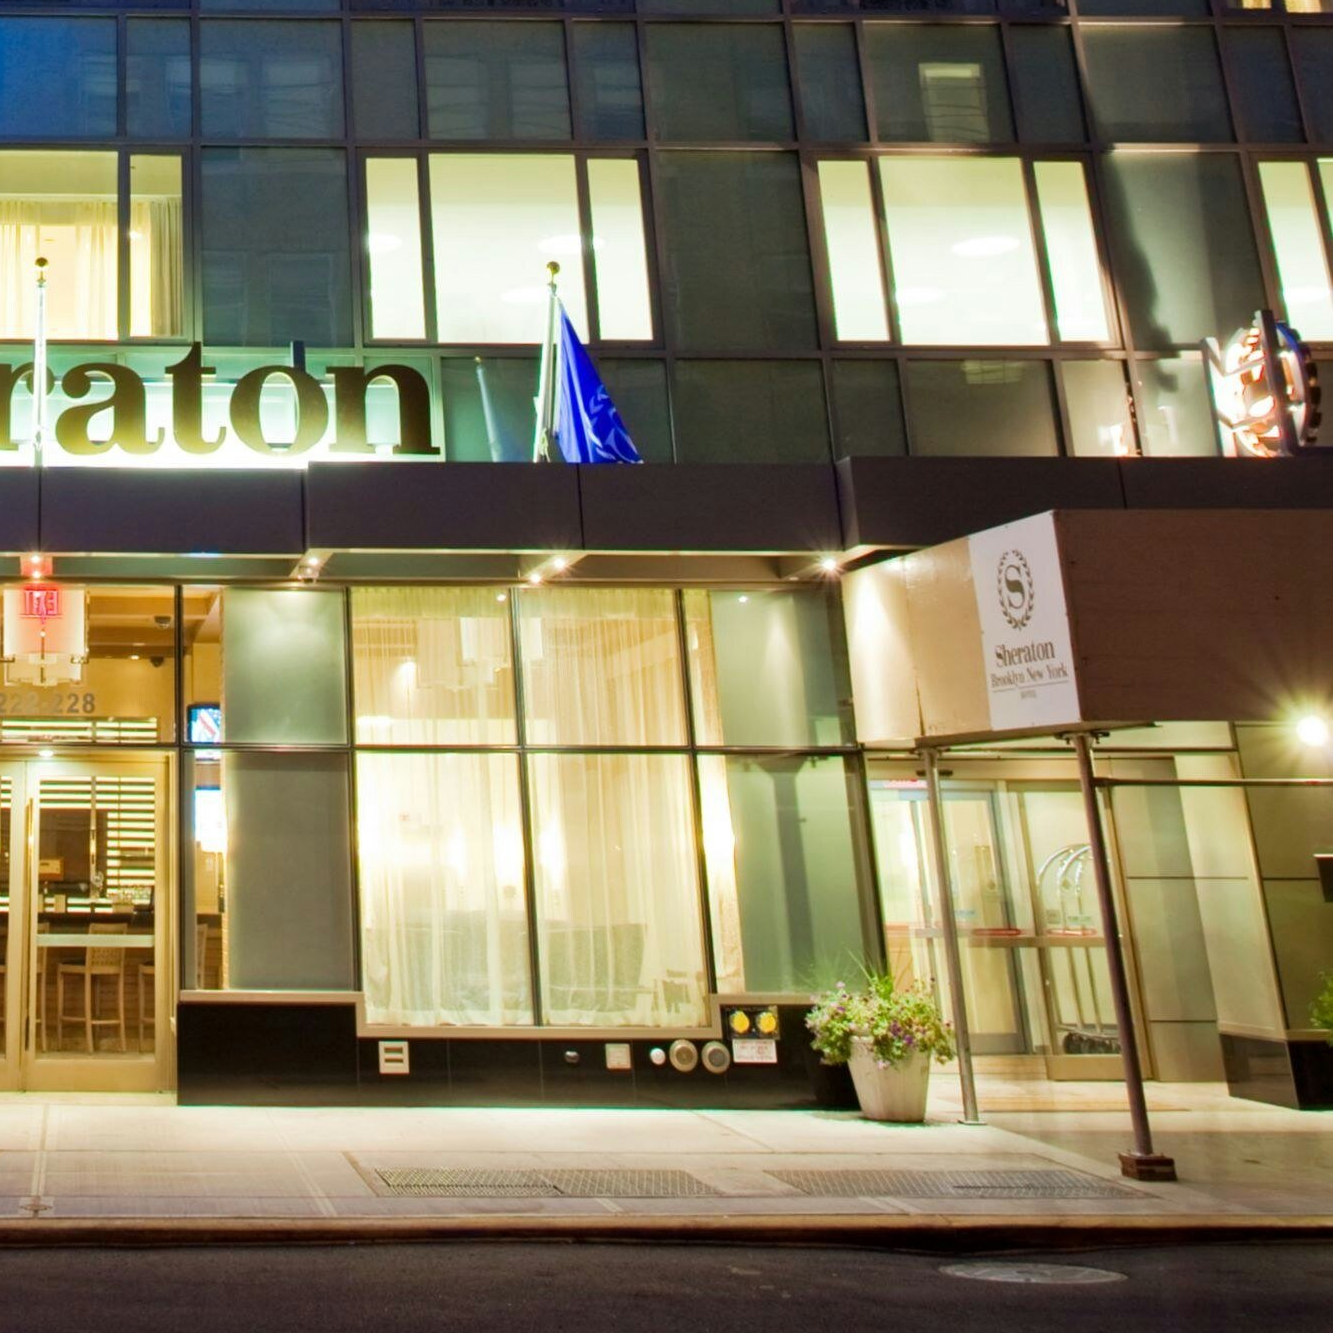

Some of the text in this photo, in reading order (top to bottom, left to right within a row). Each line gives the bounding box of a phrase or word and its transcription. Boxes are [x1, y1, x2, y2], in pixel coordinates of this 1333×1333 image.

[1004, 564, 1025, 609] S
[995, 641, 1055, 668] Sheraton
[991, 662, 1068, 688] Brooklyn New York
